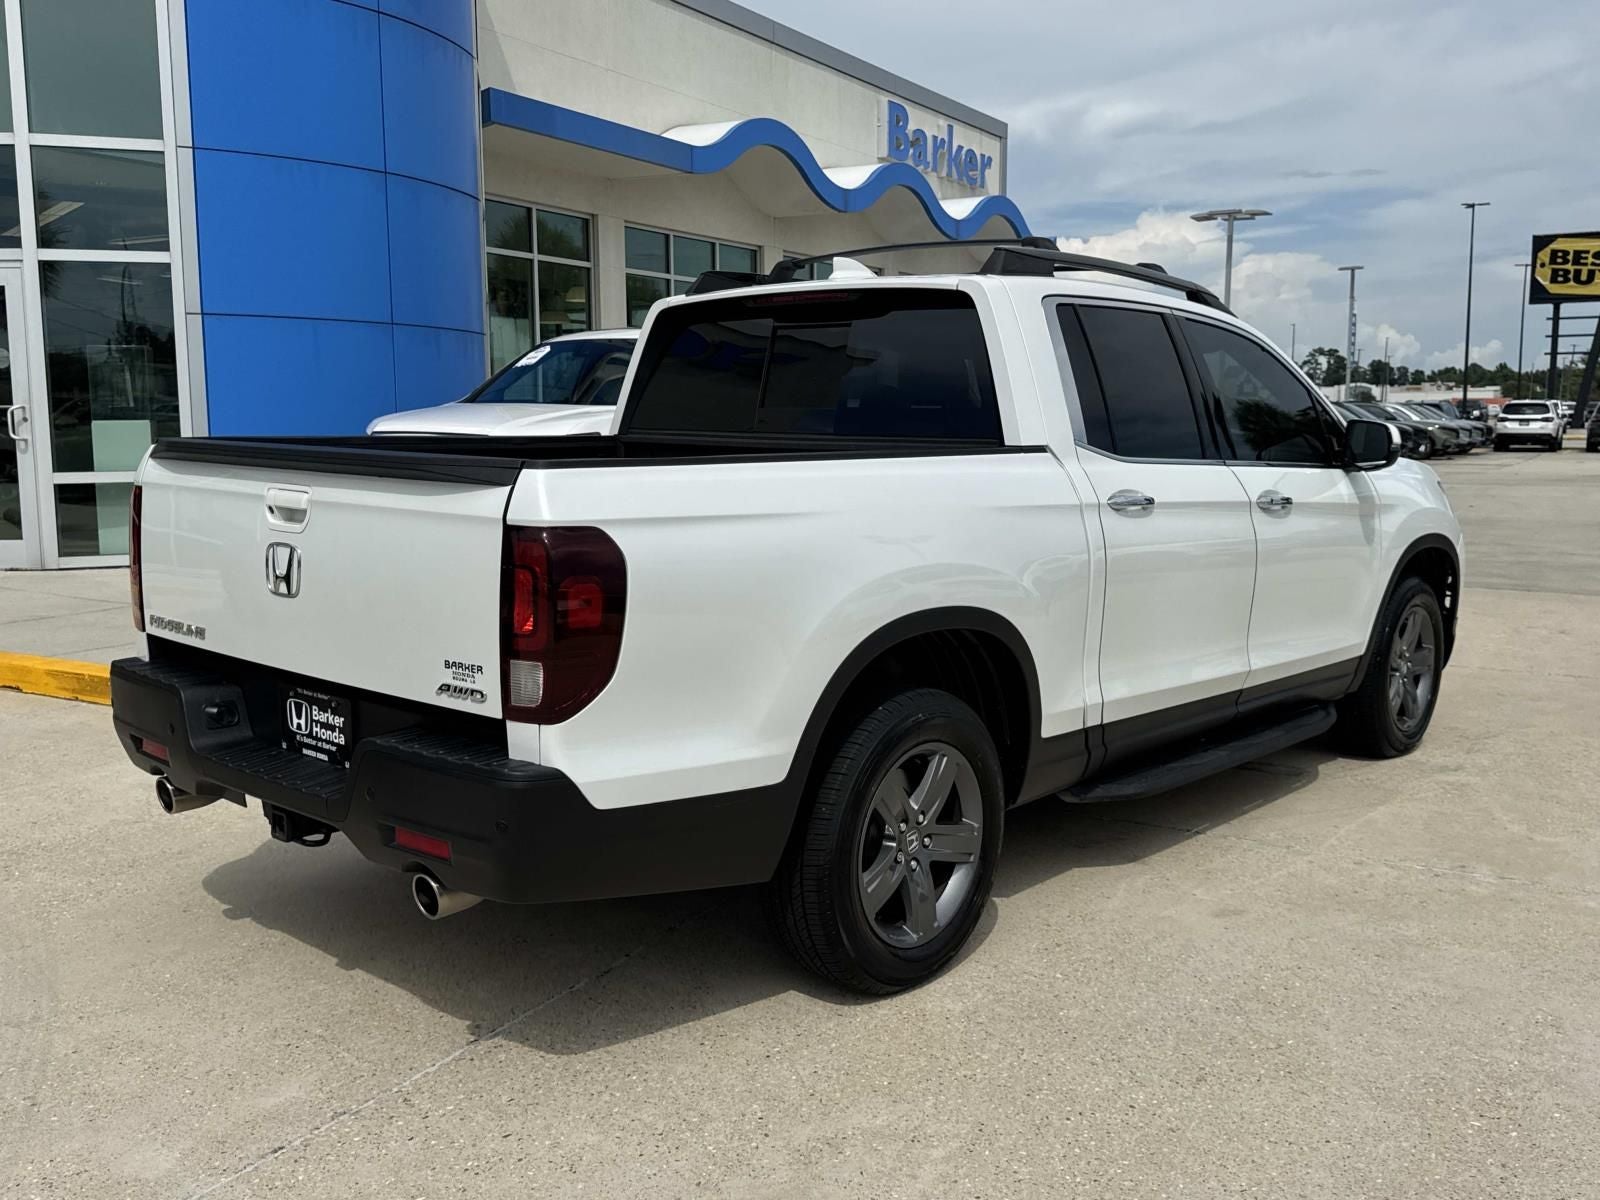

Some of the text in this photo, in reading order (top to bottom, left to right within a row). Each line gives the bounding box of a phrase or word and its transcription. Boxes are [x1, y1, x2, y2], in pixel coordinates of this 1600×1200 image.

[888, 100, 992, 189] Barker
[1550, 268, 1600, 285] BU
[444, 659, 483, 675] BARKER
[452, 671, 476, 679] HONDA
[435, 683, 487, 704] AWD
[312, 705, 344, 728] Barker
[312, 722, 345, 745] Honda
